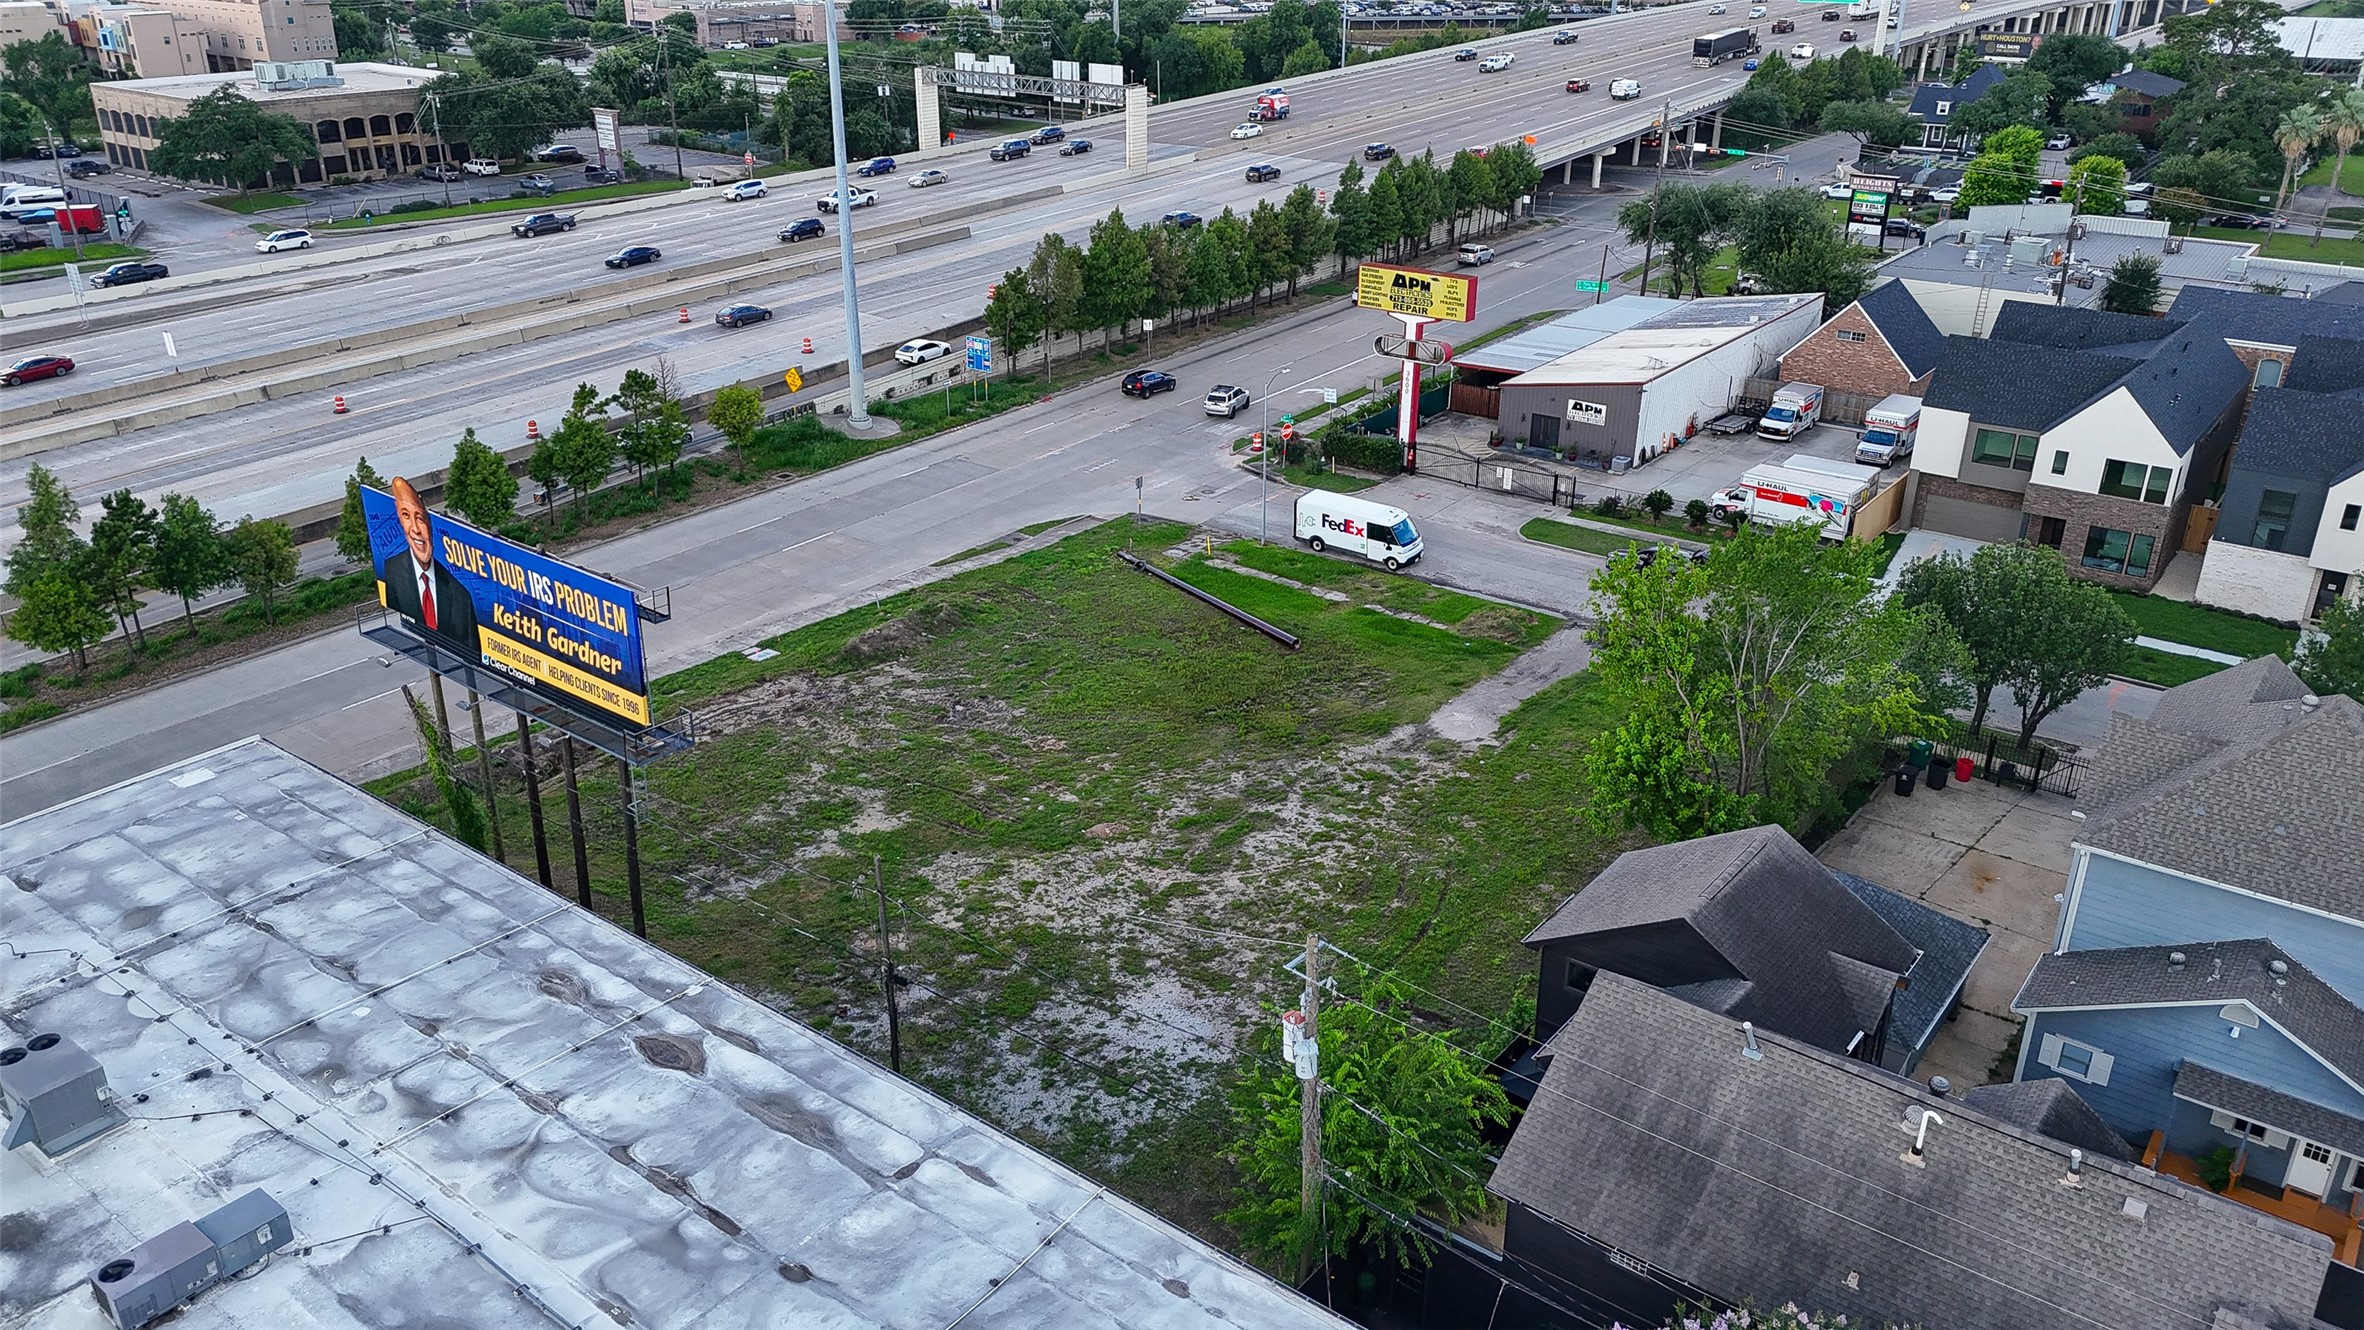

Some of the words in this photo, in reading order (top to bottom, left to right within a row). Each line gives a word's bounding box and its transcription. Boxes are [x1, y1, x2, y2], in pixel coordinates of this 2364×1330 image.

[1853, 178, 1892, 186] HEIGHTS
[1855, 193, 1886, 202] SUBWAY
[1392, 273, 1431, 292] APM
[1390, 286, 1433, 299] ELECTRONICS
[1393, 303, 1428, 315] REPAIR
[1571, 401, 1602, 415] APM
[1870, 416, 1899, 426] U-HAUL
[1758, 481, 1788, 492] U-HAUL
[1322, 513, 1365, 538] FedEx
[442, 536, 488, 578] SOLVE
[486, 553, 528, 594] YOUR
[527, 570, 553, 605] IRS
[554, 580, 628, 636] PROBLEM
[494, 602, 541, 642] Keith
[547, 627, 622, 675] Gardner
[488, 637, 511, 658] FORMER
[512, 648, 521, 663] IRS
[522, 653, 541, 672] AGENT
[490, 658, 507, 672] Clear
[508, 666, 535, 685] Channel
[549, 665, 574, 686] HELPING
[575, 677, 600, 698] CLIENTS
[601, 688, 621, 707] SINCE
[622, 698, 639, 715] 1996
